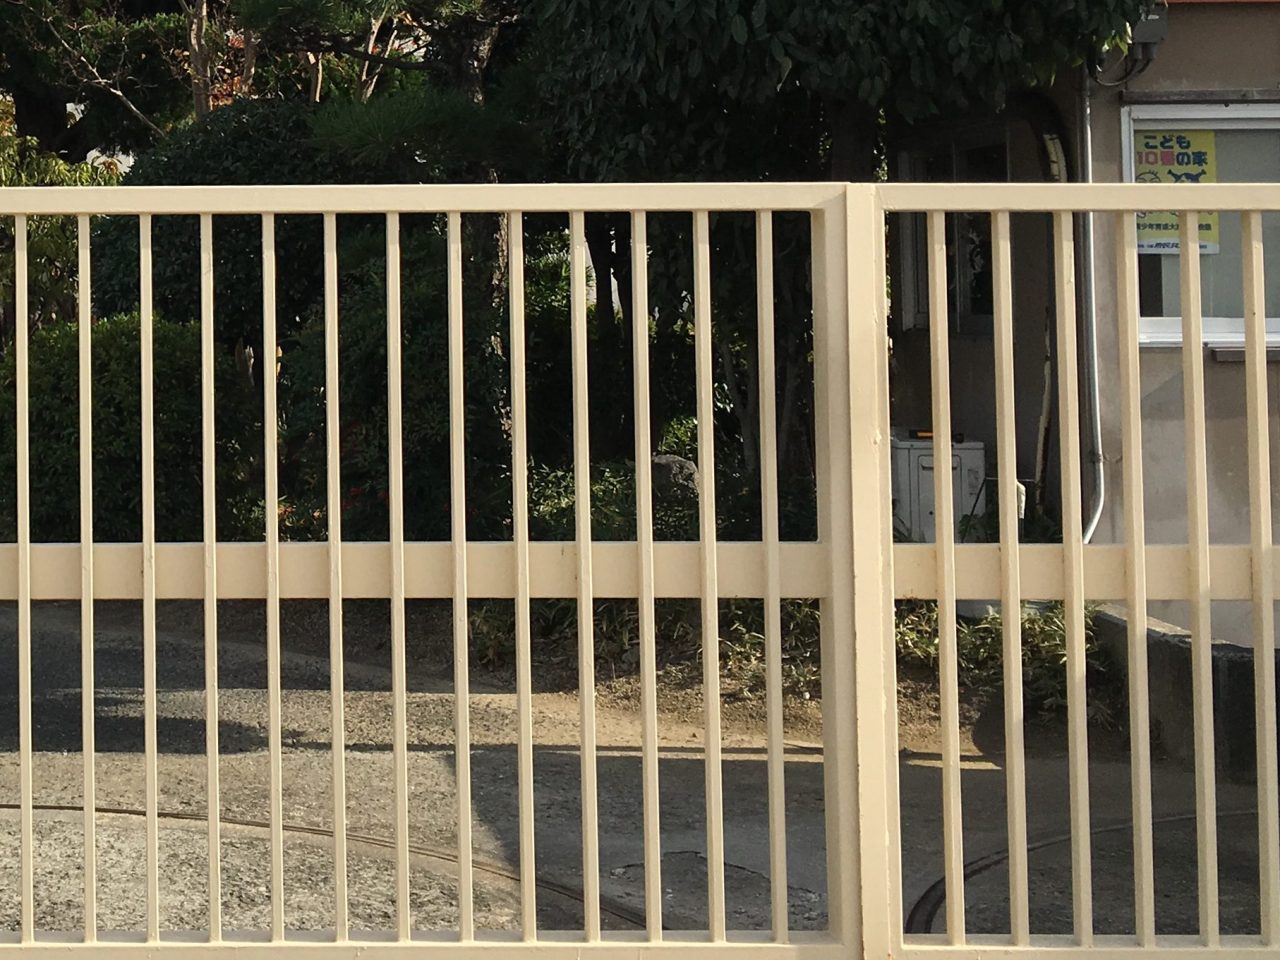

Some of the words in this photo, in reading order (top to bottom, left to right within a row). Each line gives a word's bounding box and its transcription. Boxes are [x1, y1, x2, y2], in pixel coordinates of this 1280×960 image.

[1143, 134, 1191, 150] こども
[1136, 150, 1209, 167] 10番の家
